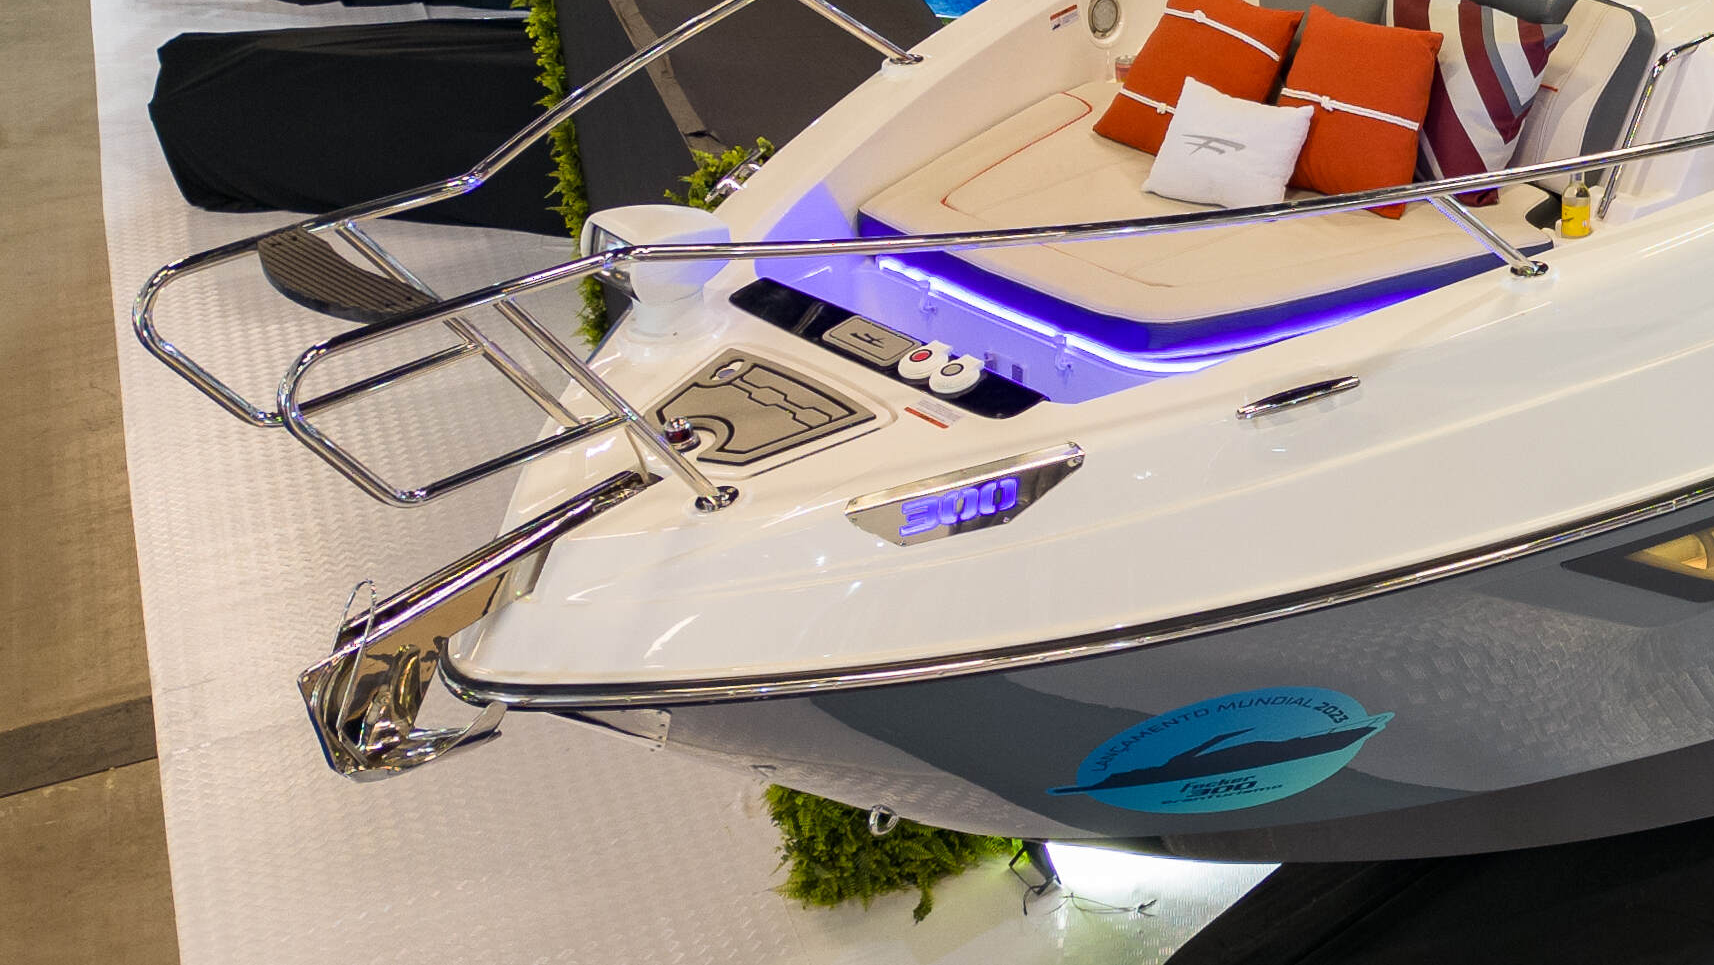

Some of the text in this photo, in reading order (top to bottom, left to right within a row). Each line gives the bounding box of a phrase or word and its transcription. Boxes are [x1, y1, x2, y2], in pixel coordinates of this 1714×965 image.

[899, 476, 1020, 537] 300
[1091, 695, 1349, 772] LANÇAMENTO MUNDIAL 2023
